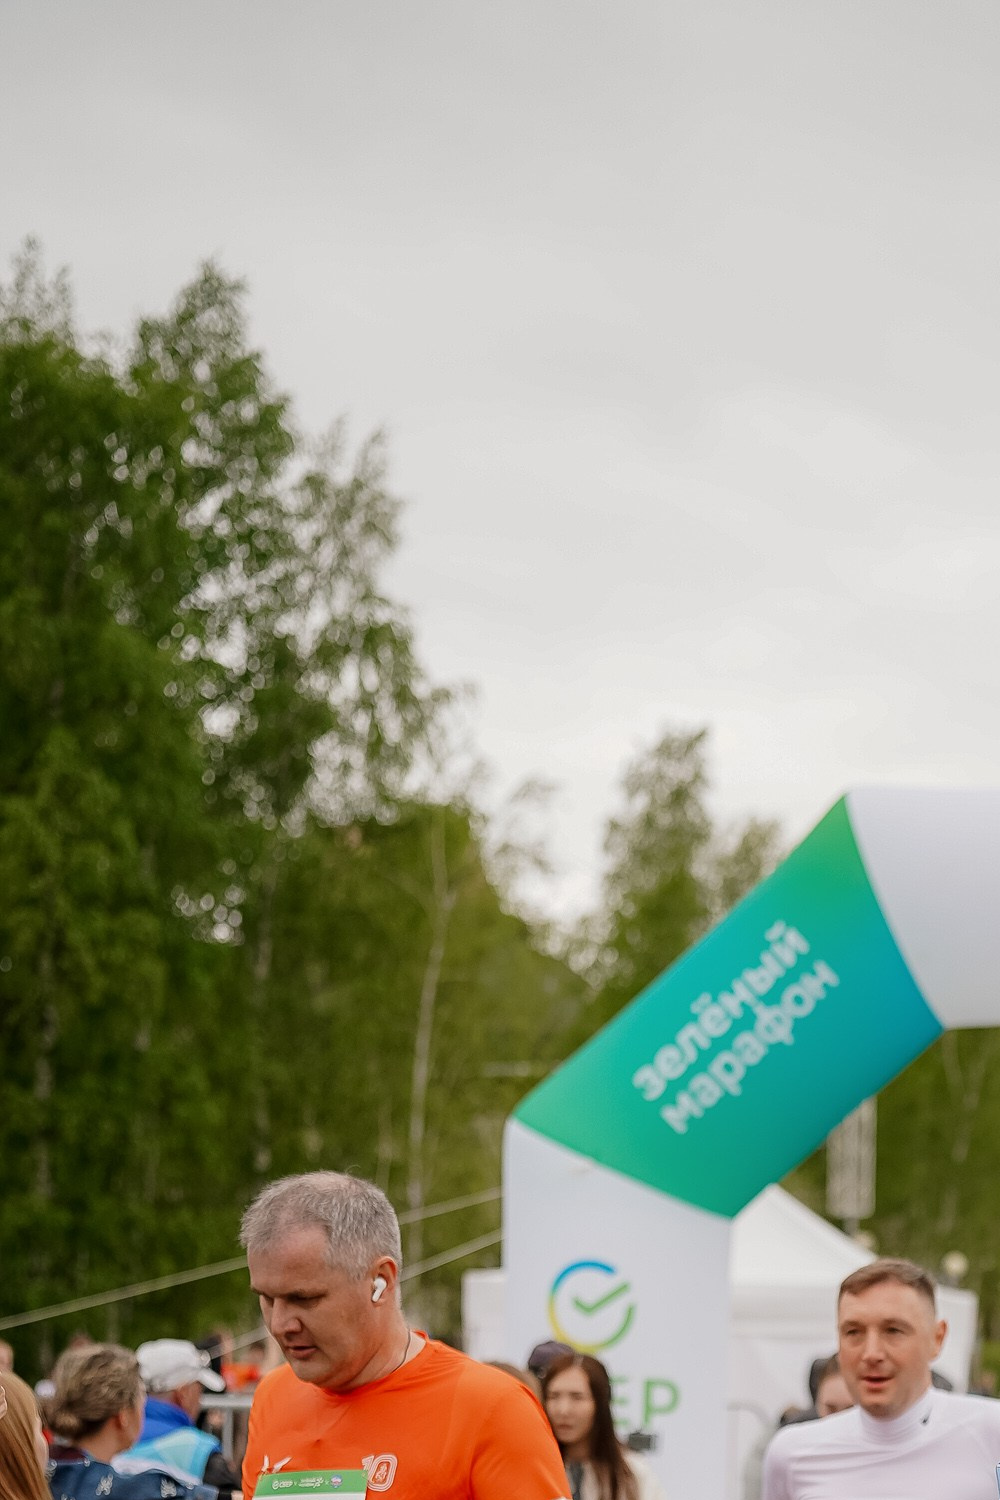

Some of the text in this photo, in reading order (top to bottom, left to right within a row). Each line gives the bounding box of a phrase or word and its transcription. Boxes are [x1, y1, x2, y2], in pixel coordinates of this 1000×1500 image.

[631, 920, 811, 1101] зелёный
[659, 959, 840, 1134] марафон
[610, 1376, 681, 1429] ЕР
